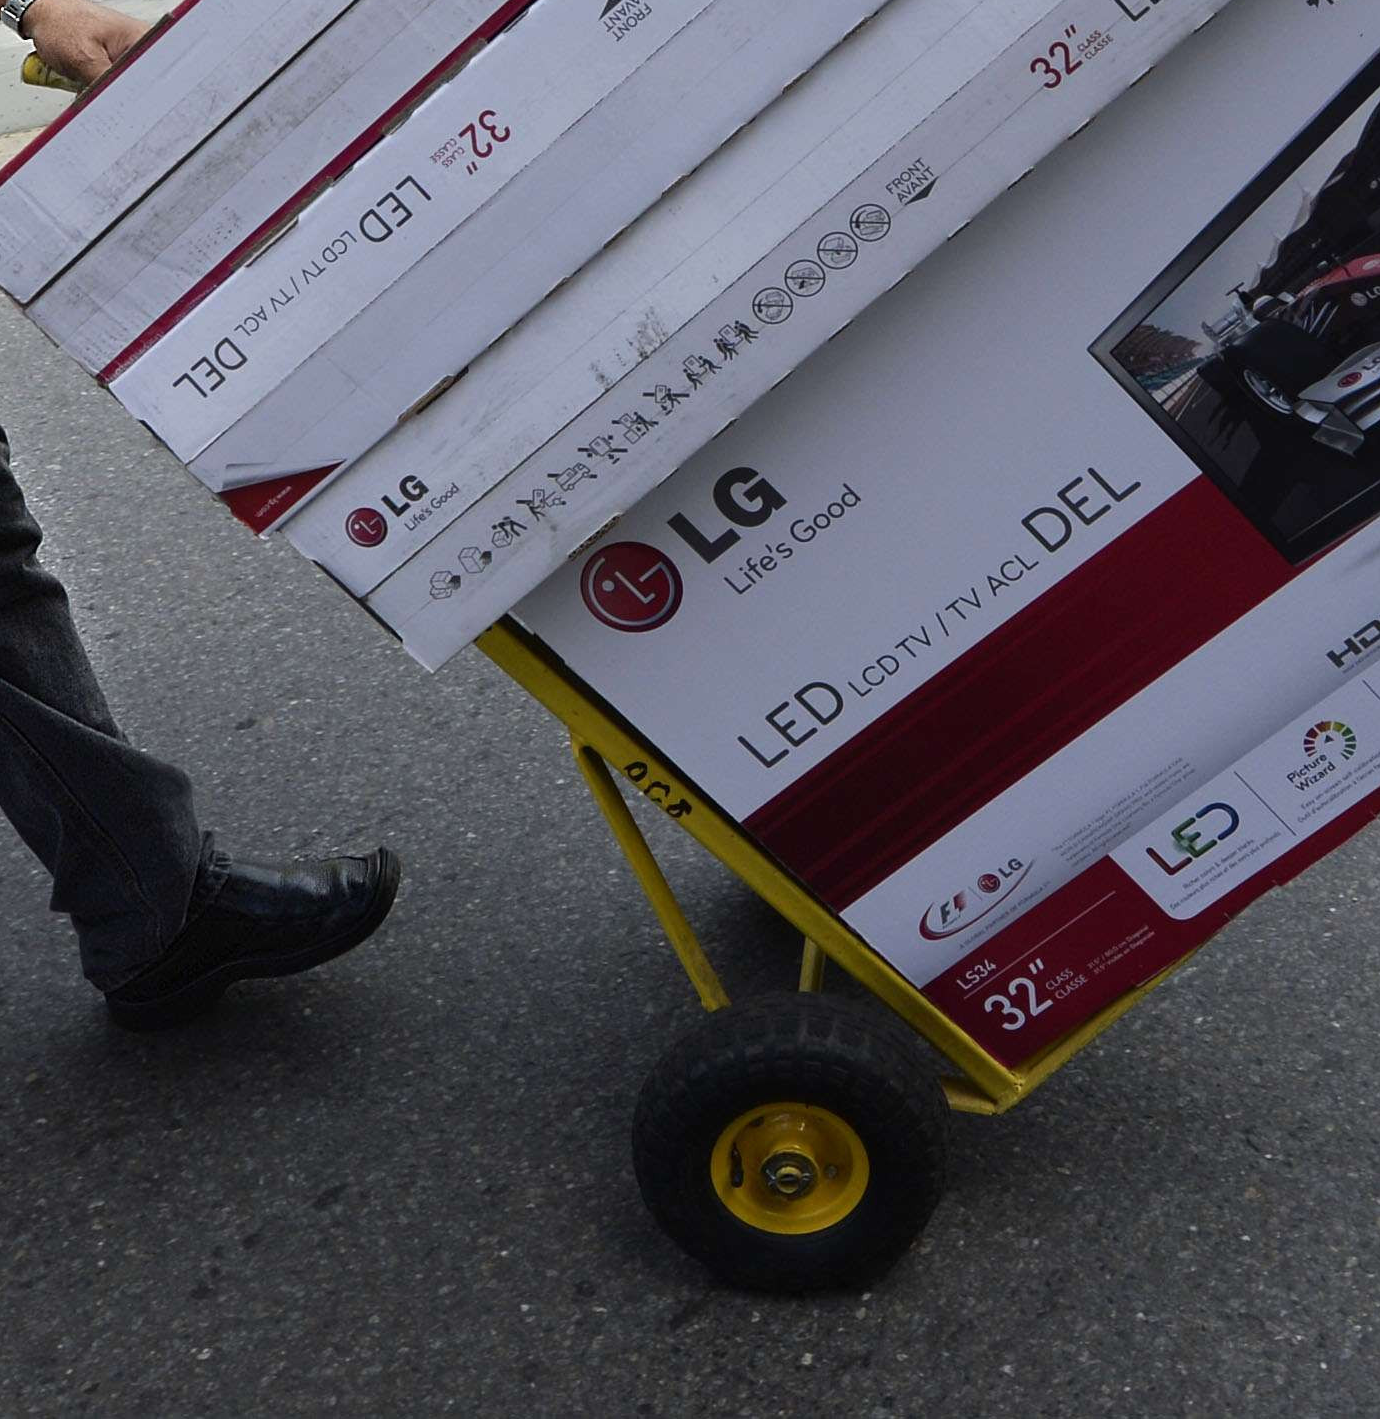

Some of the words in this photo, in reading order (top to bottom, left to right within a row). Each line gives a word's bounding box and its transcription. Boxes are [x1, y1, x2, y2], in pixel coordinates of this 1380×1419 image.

[611, 2, 653, 43] FRONT
[1029, 24, 1083, 89] 32"
[1076, 29, 1102, 53] CLASS
[1083, 34, 1115, 60] CLASSE
[429, 136, 459, 165] CLASSE
[441, 145, 466, 168] CLASS
[458, 109, 511, 176] 32"
[884, 156, 927, 196] FRONT
[895, 165, 936, 204] AVANT
[358, 174, 432, 243] LED
[321, 229, 359, 264] LCD
[290, 276, 301, 295] /
[301, 259, 326, 285] TV
[269, 287, 295, 315] TV
[233, 306, 269, 337] ACL
[172, 336, 249, 399] DEL
[380, 474, 430, 518] LG
[404, 507, 433, 532] Life's
[430, 482, 461, 510] Good
[666, 466, 789, 565] LG
[723, 541, 794, 595] Life's
[789, 482, 862, 544] Good
[736, 680, 844, 769] LED
[847, 654, 901, 698] LCD
[894, 625, 932, 659] TV
[934, 611, 951, 637] /
[944, 586, 982, 620] TV
[985, 553, 1040, 597] ACL
[1021, 466, 1142, 554] DEL
[1285, 753, 1328, 785] Picture
[1294, 761, 1337, 794] Wizard
[1146, 801, 1240, 876] LED
[997, 857, 1024, 879] LG
[955, 958, 998, 991] LS34
[1045, 967, 1075, 992] CLASS
[1054, 974, 1089, 1000] CLASSE
[983, 957, 1055, 1031] 32"
